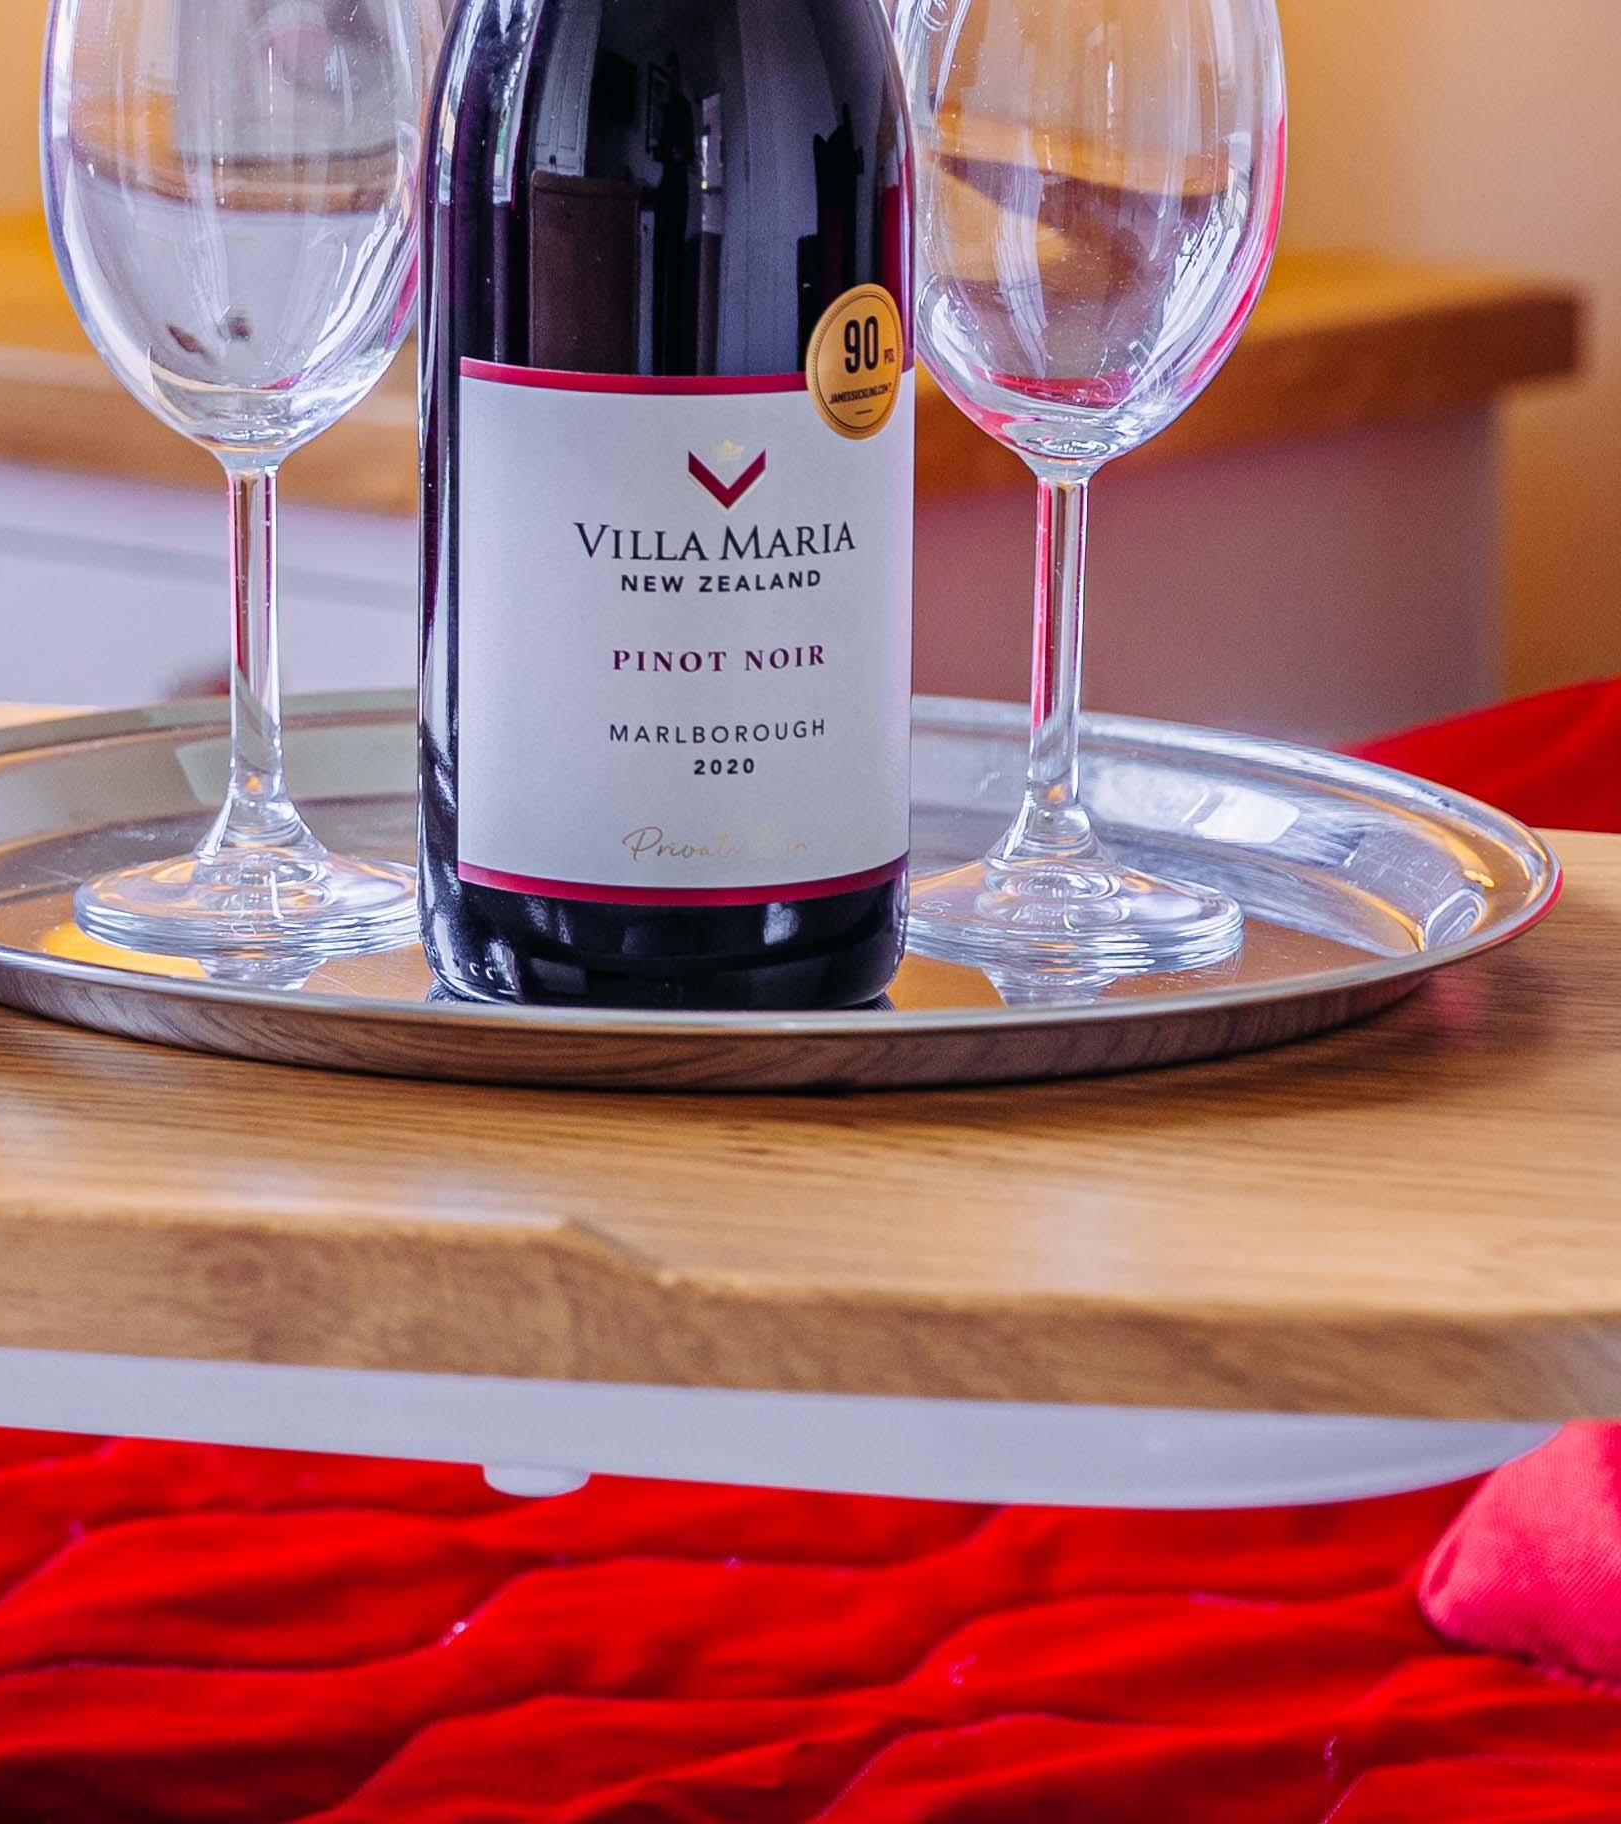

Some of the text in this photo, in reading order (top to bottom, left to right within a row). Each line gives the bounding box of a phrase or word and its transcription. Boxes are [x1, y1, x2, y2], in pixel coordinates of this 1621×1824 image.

[844, 315, 879, 374] 90
[573, 521, 856, 562] VILLA MARIA
[621, 570, 822, 593] NEW ZEALAND
[612, 644, 825, 673] PINOT NOIR
[609, 718, 825, 744] MARLBOROUGH
[693, 757, 755, 776] 2020
